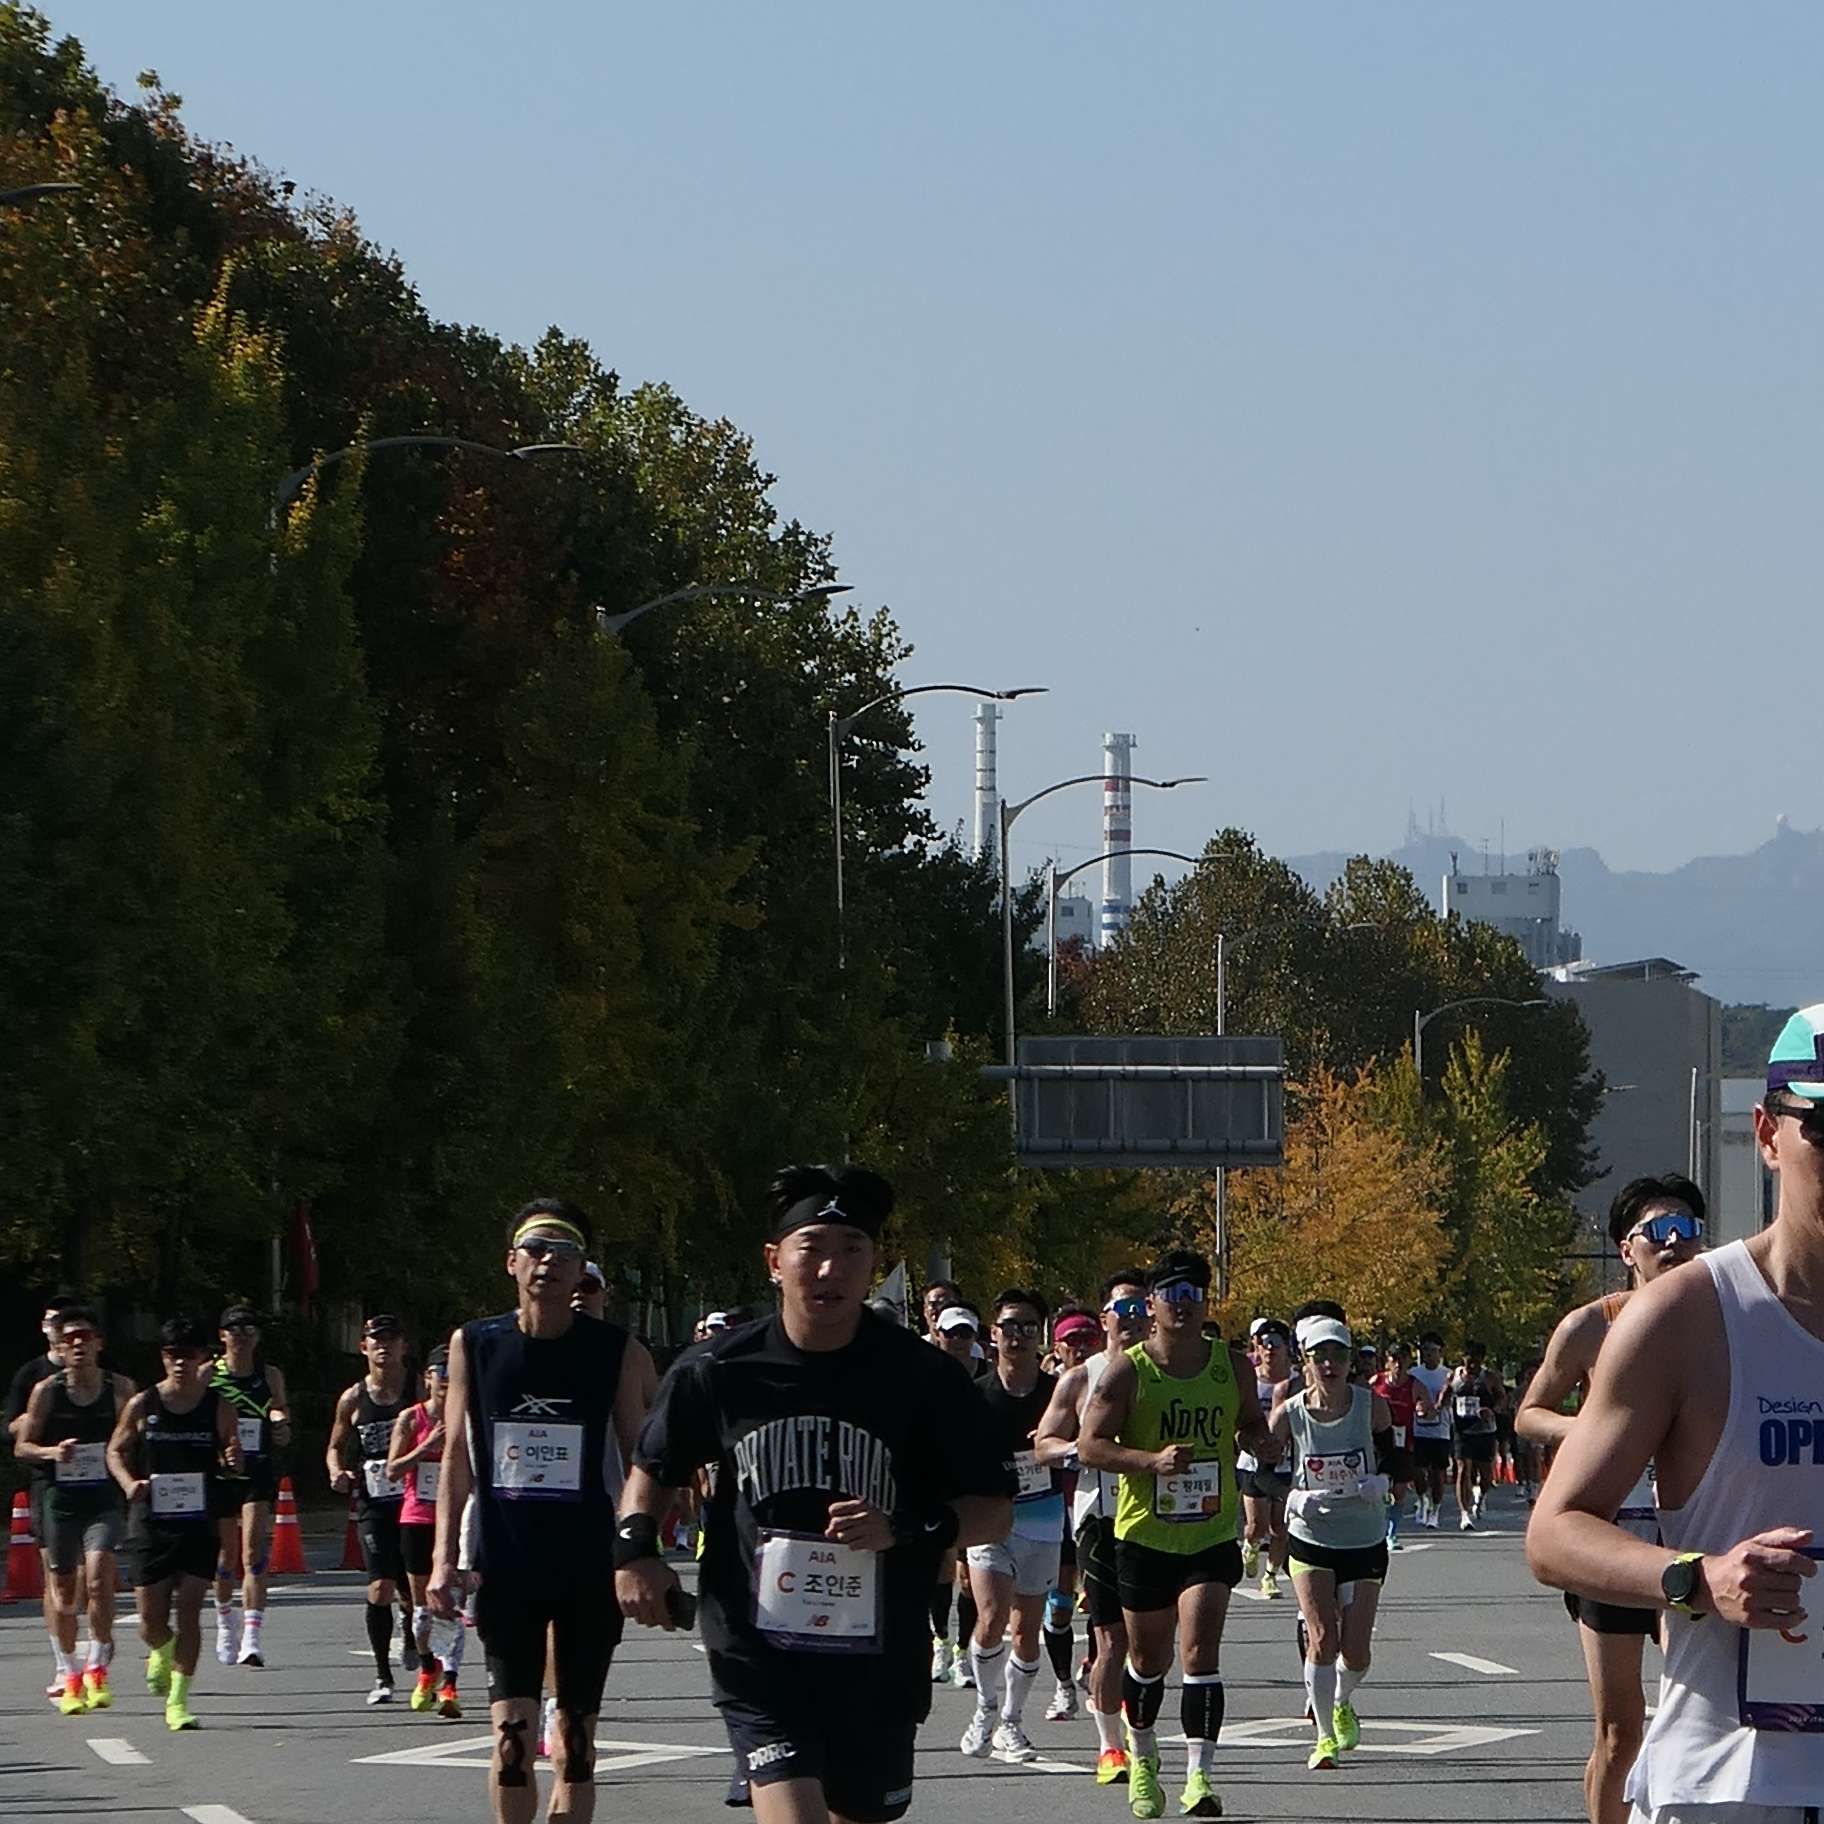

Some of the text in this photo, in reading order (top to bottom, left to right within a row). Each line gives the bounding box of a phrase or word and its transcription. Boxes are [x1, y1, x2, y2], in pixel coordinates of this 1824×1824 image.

[1756, 1395, 1823, 1414] Design
[1159, 1397, 1224, 1448] NDRC
[507, 1445, 520, 1461] C
[733, 1414, 897, 1517] PRIVATE ROAD
[1167, 1481, 1178, 1493] C
[808, 1550, 837, 1565] AIA
[777, 1571, 862, 1599] C 조인준
